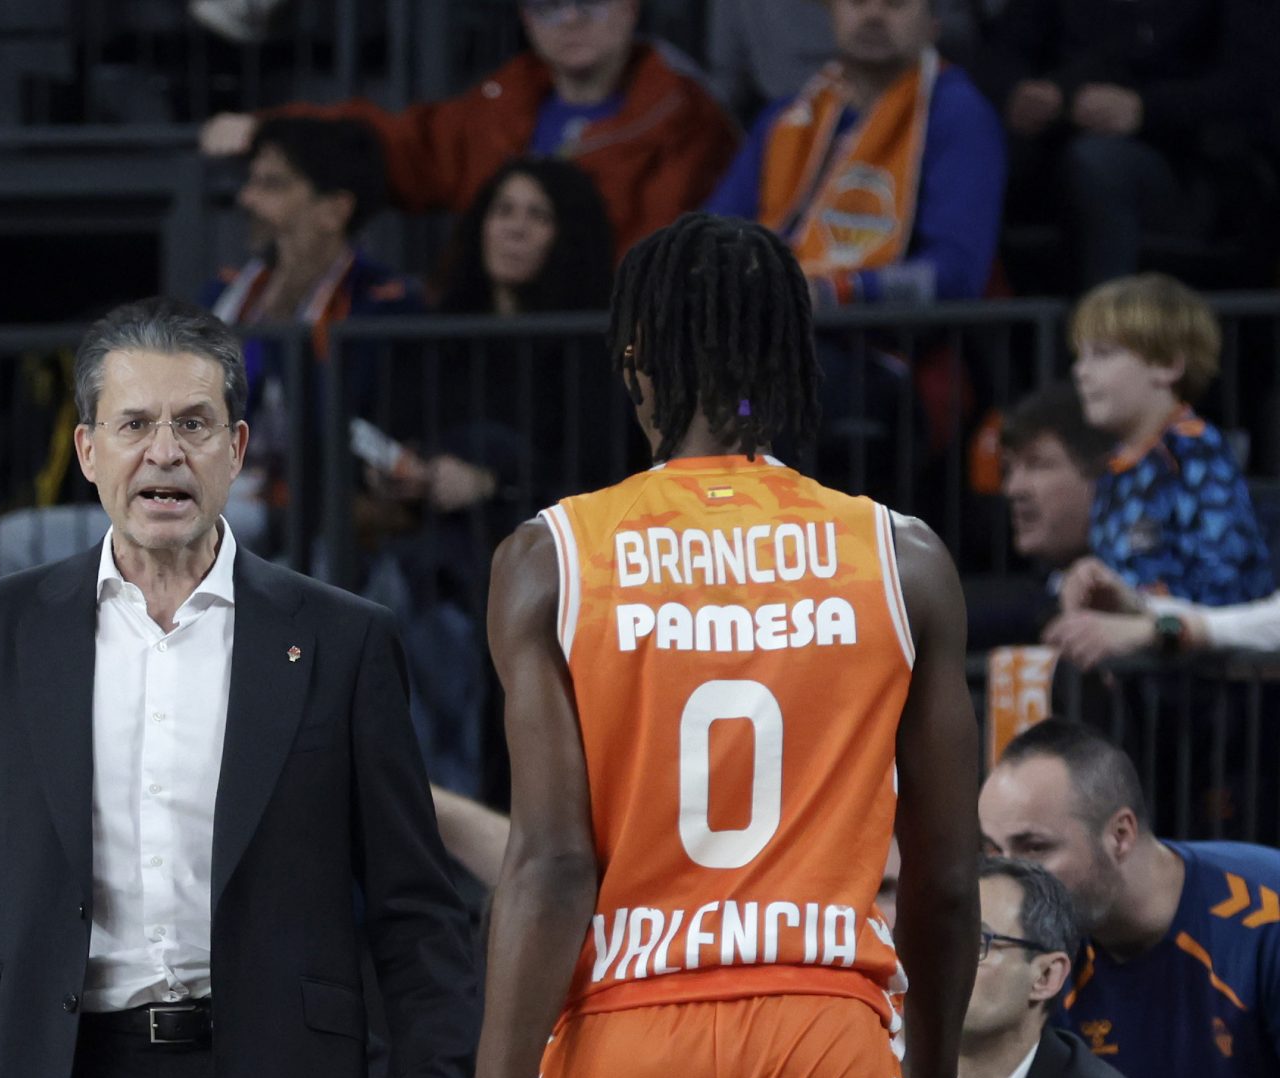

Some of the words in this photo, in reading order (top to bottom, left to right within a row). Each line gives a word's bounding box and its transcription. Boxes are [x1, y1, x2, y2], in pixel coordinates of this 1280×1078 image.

[616, 522, 839, 588] BRANCOU
[617, 597, 857, 652] PAMESA
[678, 679, 784, 869] 0
[591, 900, 857, 983] VALENCIA
